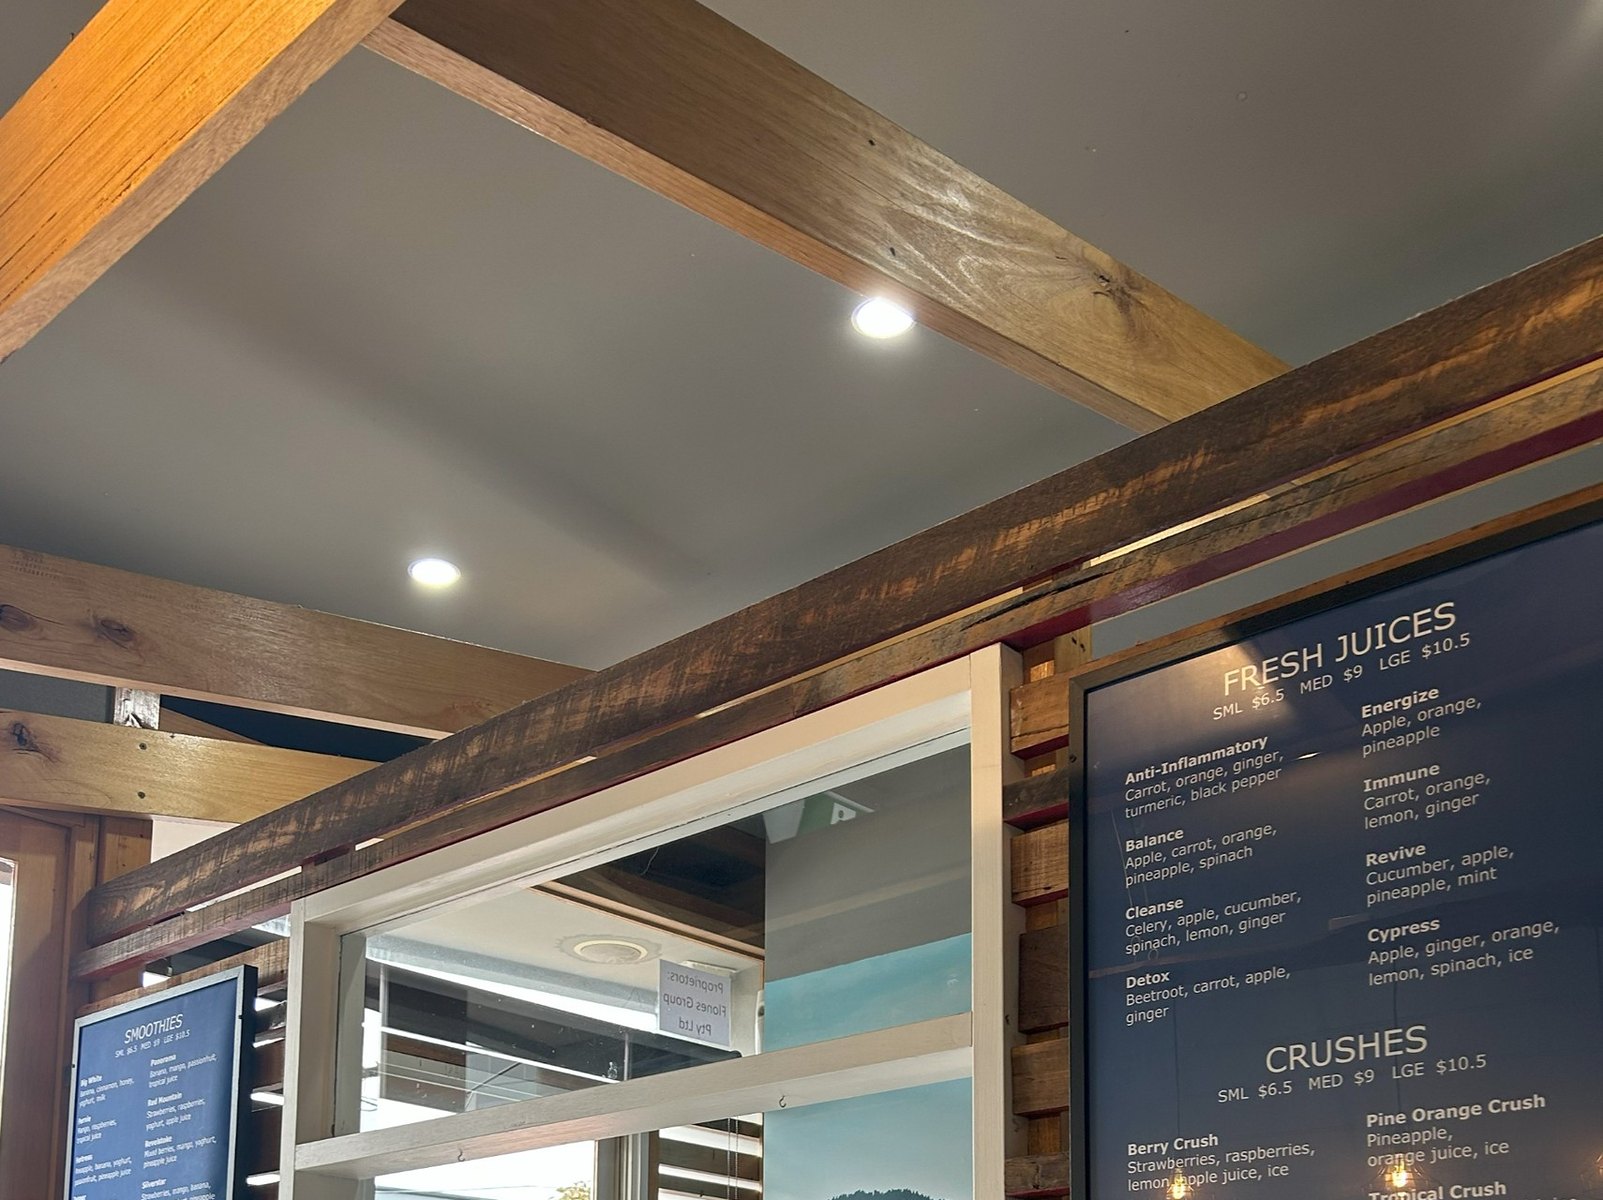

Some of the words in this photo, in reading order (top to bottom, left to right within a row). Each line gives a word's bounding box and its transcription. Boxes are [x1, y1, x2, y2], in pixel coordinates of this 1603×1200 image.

[1225, 644, 1322, 695] FRESH
[1336, 602, 1455, 662] JUICES
[1214, 703, 1242, 720] SML
[1253, 689, 1284, 710] $6.5
[1301, 675, 1332, 693] MED
[1344, 665, 1362, 682] $9
[1380, 650, 1410, 670] LGE
[1422, 633, 1469, 659] $10.5
[1362, 689, 1438, 718] Energize
[1362, 716, 1410, 736] Apple,
[1418, 698, 1481, 721] orange,
[1363, 726, 1439, 758] pineapple
[1125, 737, 1267, 785] Anti-Inflammatory
[1126, 781, 1170, 801] Carrot,
[1176, 767, 1227, 787] orange,
[1233, 752, 1283, 774] ginger,
[1364, 765, 1439, 792] Immune
[1126, 795, 1185, 818] turmeric,
[1191, 782, 1226, 800] black
[1232, 769, 1281, 792] pepper
[1365, 788, 1419, 810] Carrot,
[1426, 774, 1489, 795] orange,
[1365, 810, 1418, 829] lemon,
[1426, 794, 1479, 818] ginger
[1126, 830, 1183, 852] Balance
[1367, 845, 1425, 866] Revive
[1367, 859, 1454, 885] Cucumber,
[1462, 846, 1513, 866] apple,
[1368, 878, 1450, 907] pineapple,
[1459, 867, 1496, 885] mint
[1126, 900, 1183, 919] Cleanse
[1368, 920, 1439, 943] Cypress
[1368, 946, 1418, 965] Apple,
[1426, 935, 1485, 957] ginger,
[1492, 922, 1559, 942] orange,
[1127, 972, 1169, 988] Detox
[1370, 969, 1424, 985] lemon,
[1431, 953, 1501, 976] spinach,
[1509, 949, 1533, 962] ice
[125, 1014, 183, 1043] SMOOTHIES
[1267, 1026, 1427, 1072] CRUSHES
[1219, 1088, 1249, 1102] SML
[1259, 1081, 1291, 1098] $6.5
[1309, 1074, 1342, 1089] MED
[1355, 1070, 1374, 1085] $9
[1393, 1062, 1424, 1078] LGE
[1437, 1054, 1486, 1074] $10.5
[1367, 1113, 1406, 1127] Pine
[1412, 1105, 1482, 1121] Orange
[1489, 1094, 1545, 1113] Crush
